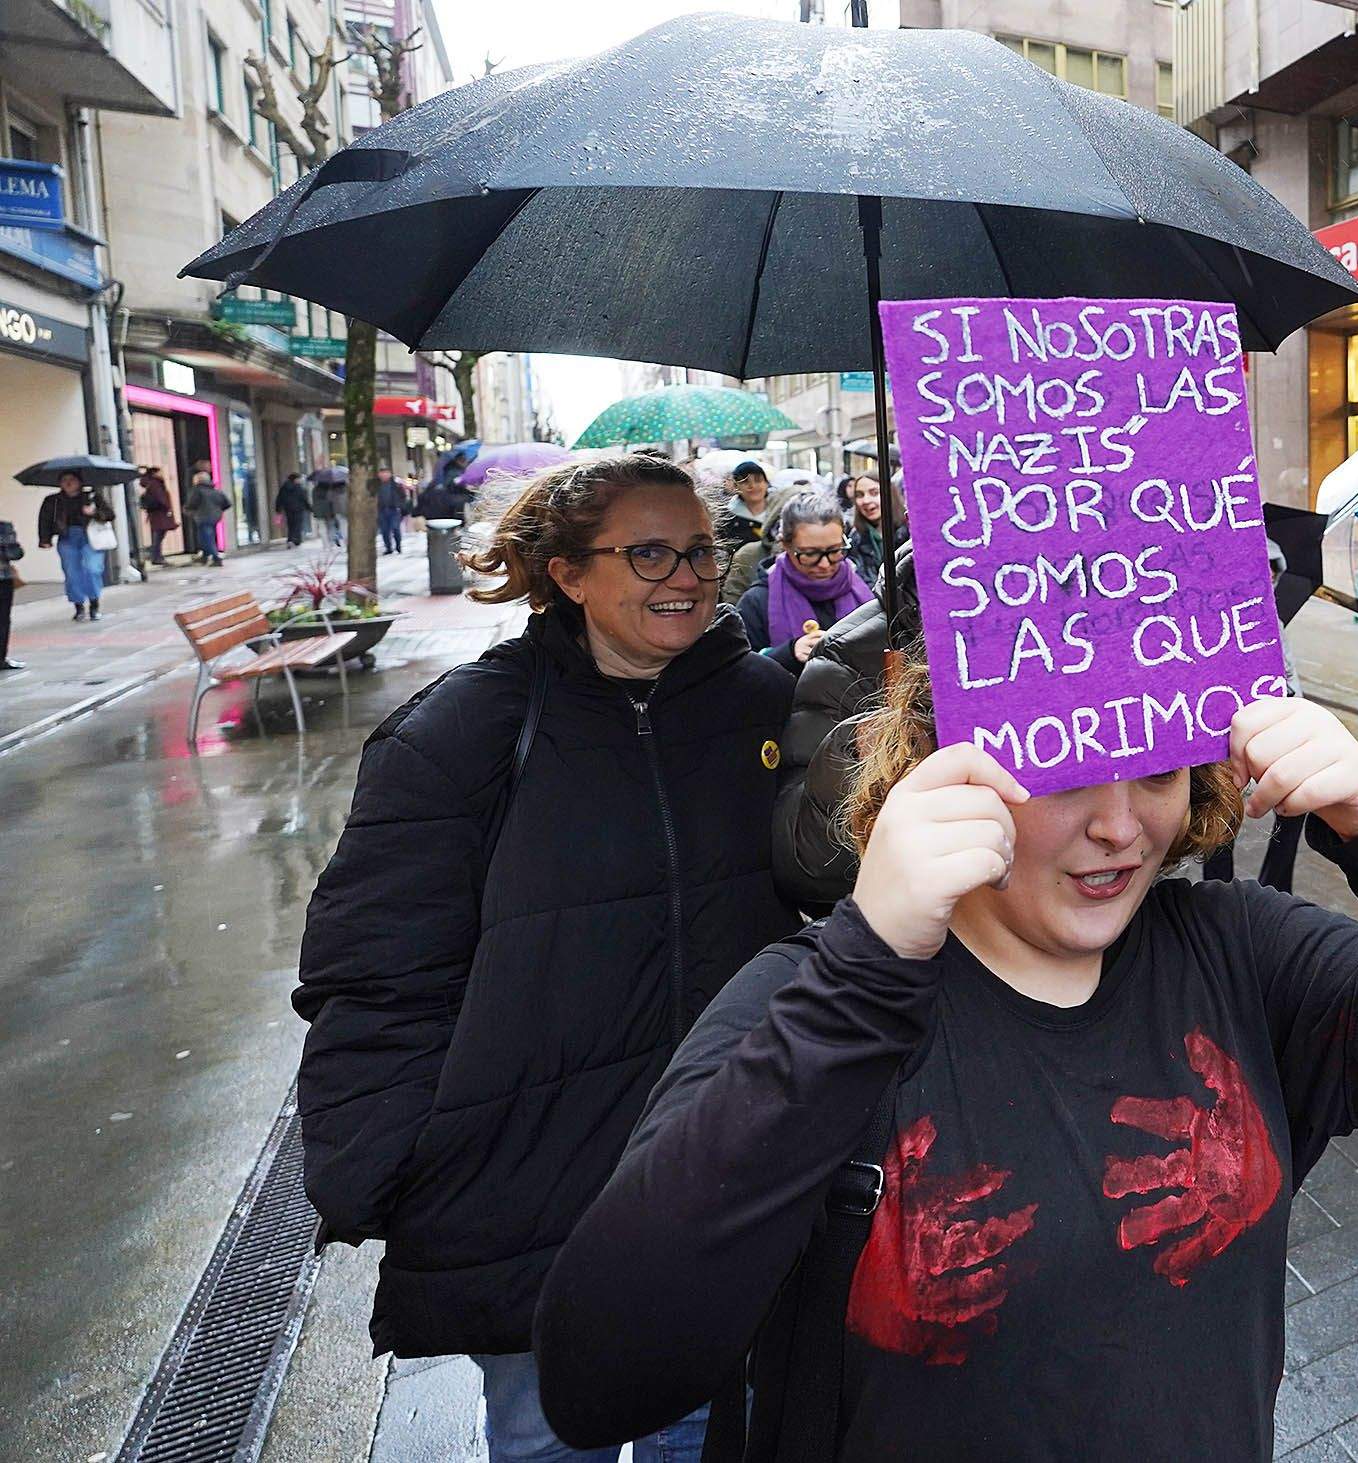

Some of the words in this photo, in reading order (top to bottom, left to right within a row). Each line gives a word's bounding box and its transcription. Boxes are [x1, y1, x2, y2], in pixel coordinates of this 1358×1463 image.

[912, 306, 983, 364] SI
[916, 370, 1105, 425] SOMOS
[1137, 366, 1242, 415] LAS
[941, 476, 1107, 548] ¿POR
[1129, 454, 1266, 533] QUÉ
[941, 545, 1178, 618] SOMOS
[954, 611, 1095, 690] LAS
[1132, 596, 1278, 666] QUE
